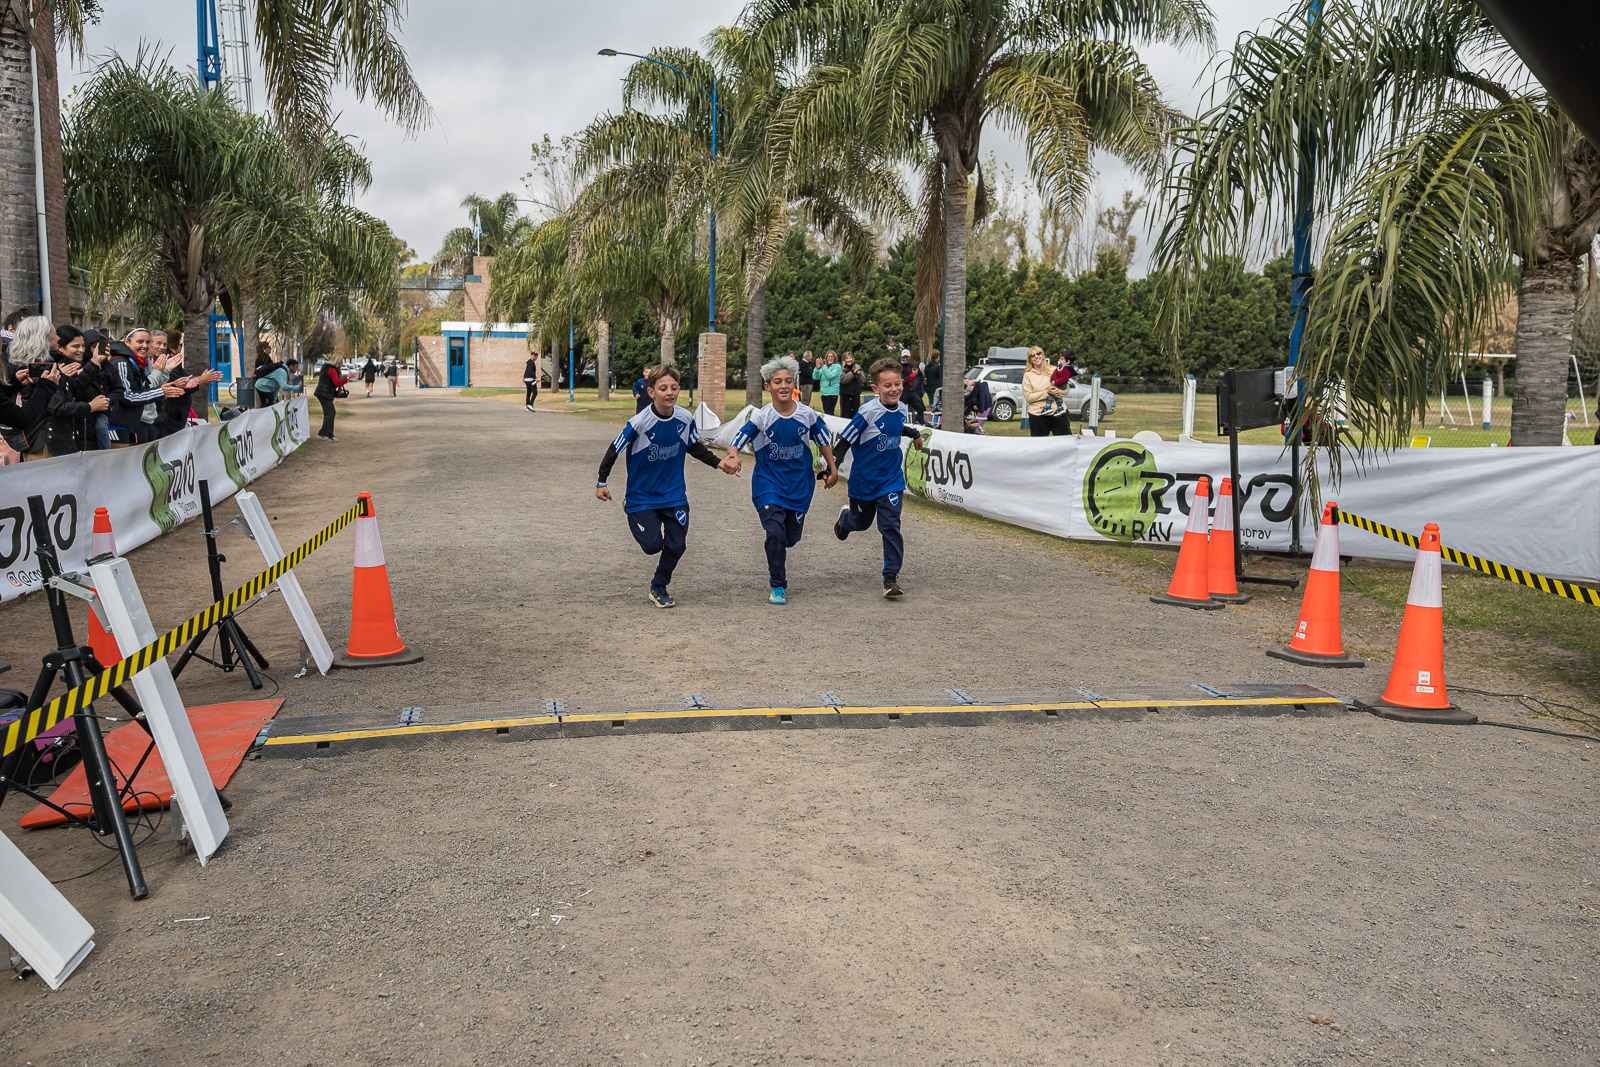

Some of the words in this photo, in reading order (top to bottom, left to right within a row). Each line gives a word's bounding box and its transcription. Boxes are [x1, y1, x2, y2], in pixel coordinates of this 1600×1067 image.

[769, 442, 779, 460] 3
[877, 433, 888, 451] 3
[648, 443, 659, 461] 3
[1131, 519, 1174, 542] RAV
